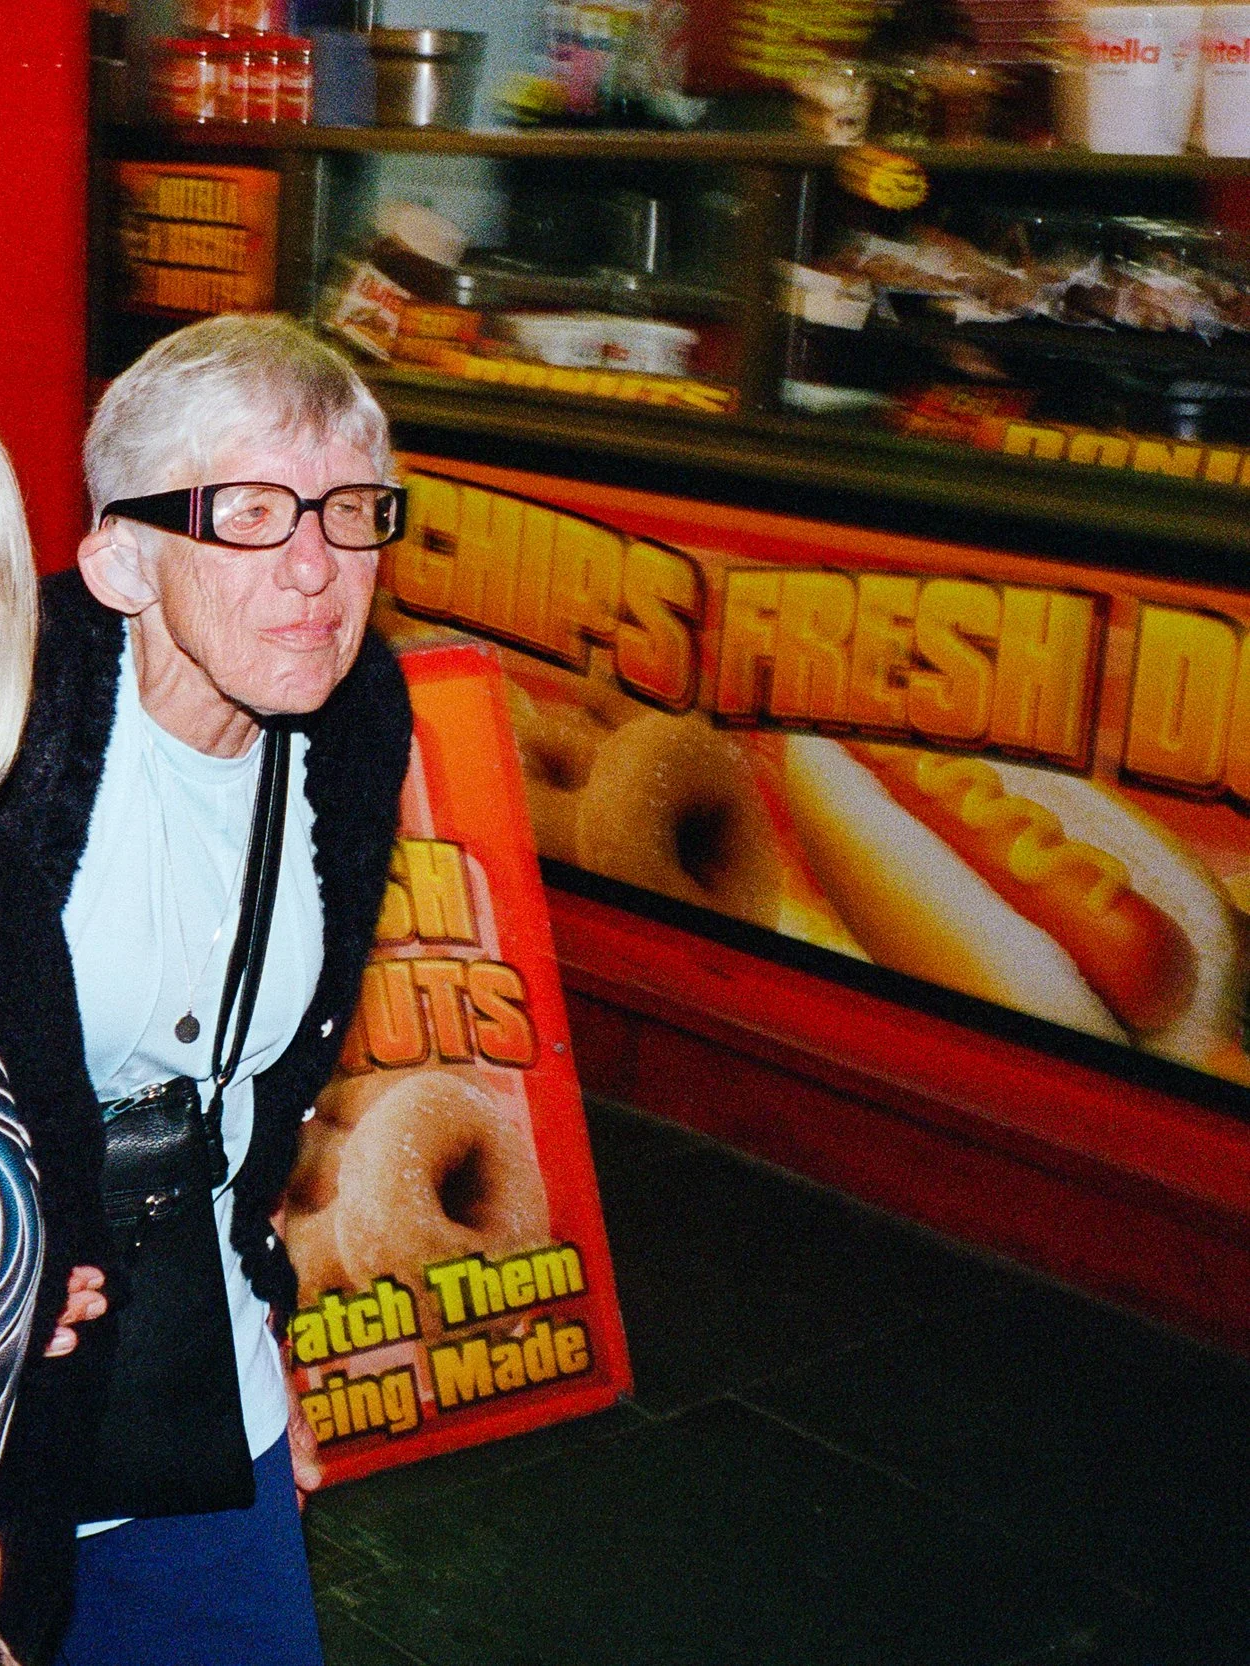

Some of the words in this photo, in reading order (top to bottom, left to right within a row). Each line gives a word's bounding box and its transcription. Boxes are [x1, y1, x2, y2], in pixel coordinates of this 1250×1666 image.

[393, 472, 700, 708] CHIPS
[716, 568, 1100, 765] FRESH
[342, 957, 540, 1070] UTS
[288, 1279, 418, 1363] atch
[427, 1246, 586, 1326] Them
[430, 1321, 592, 1408] Made
